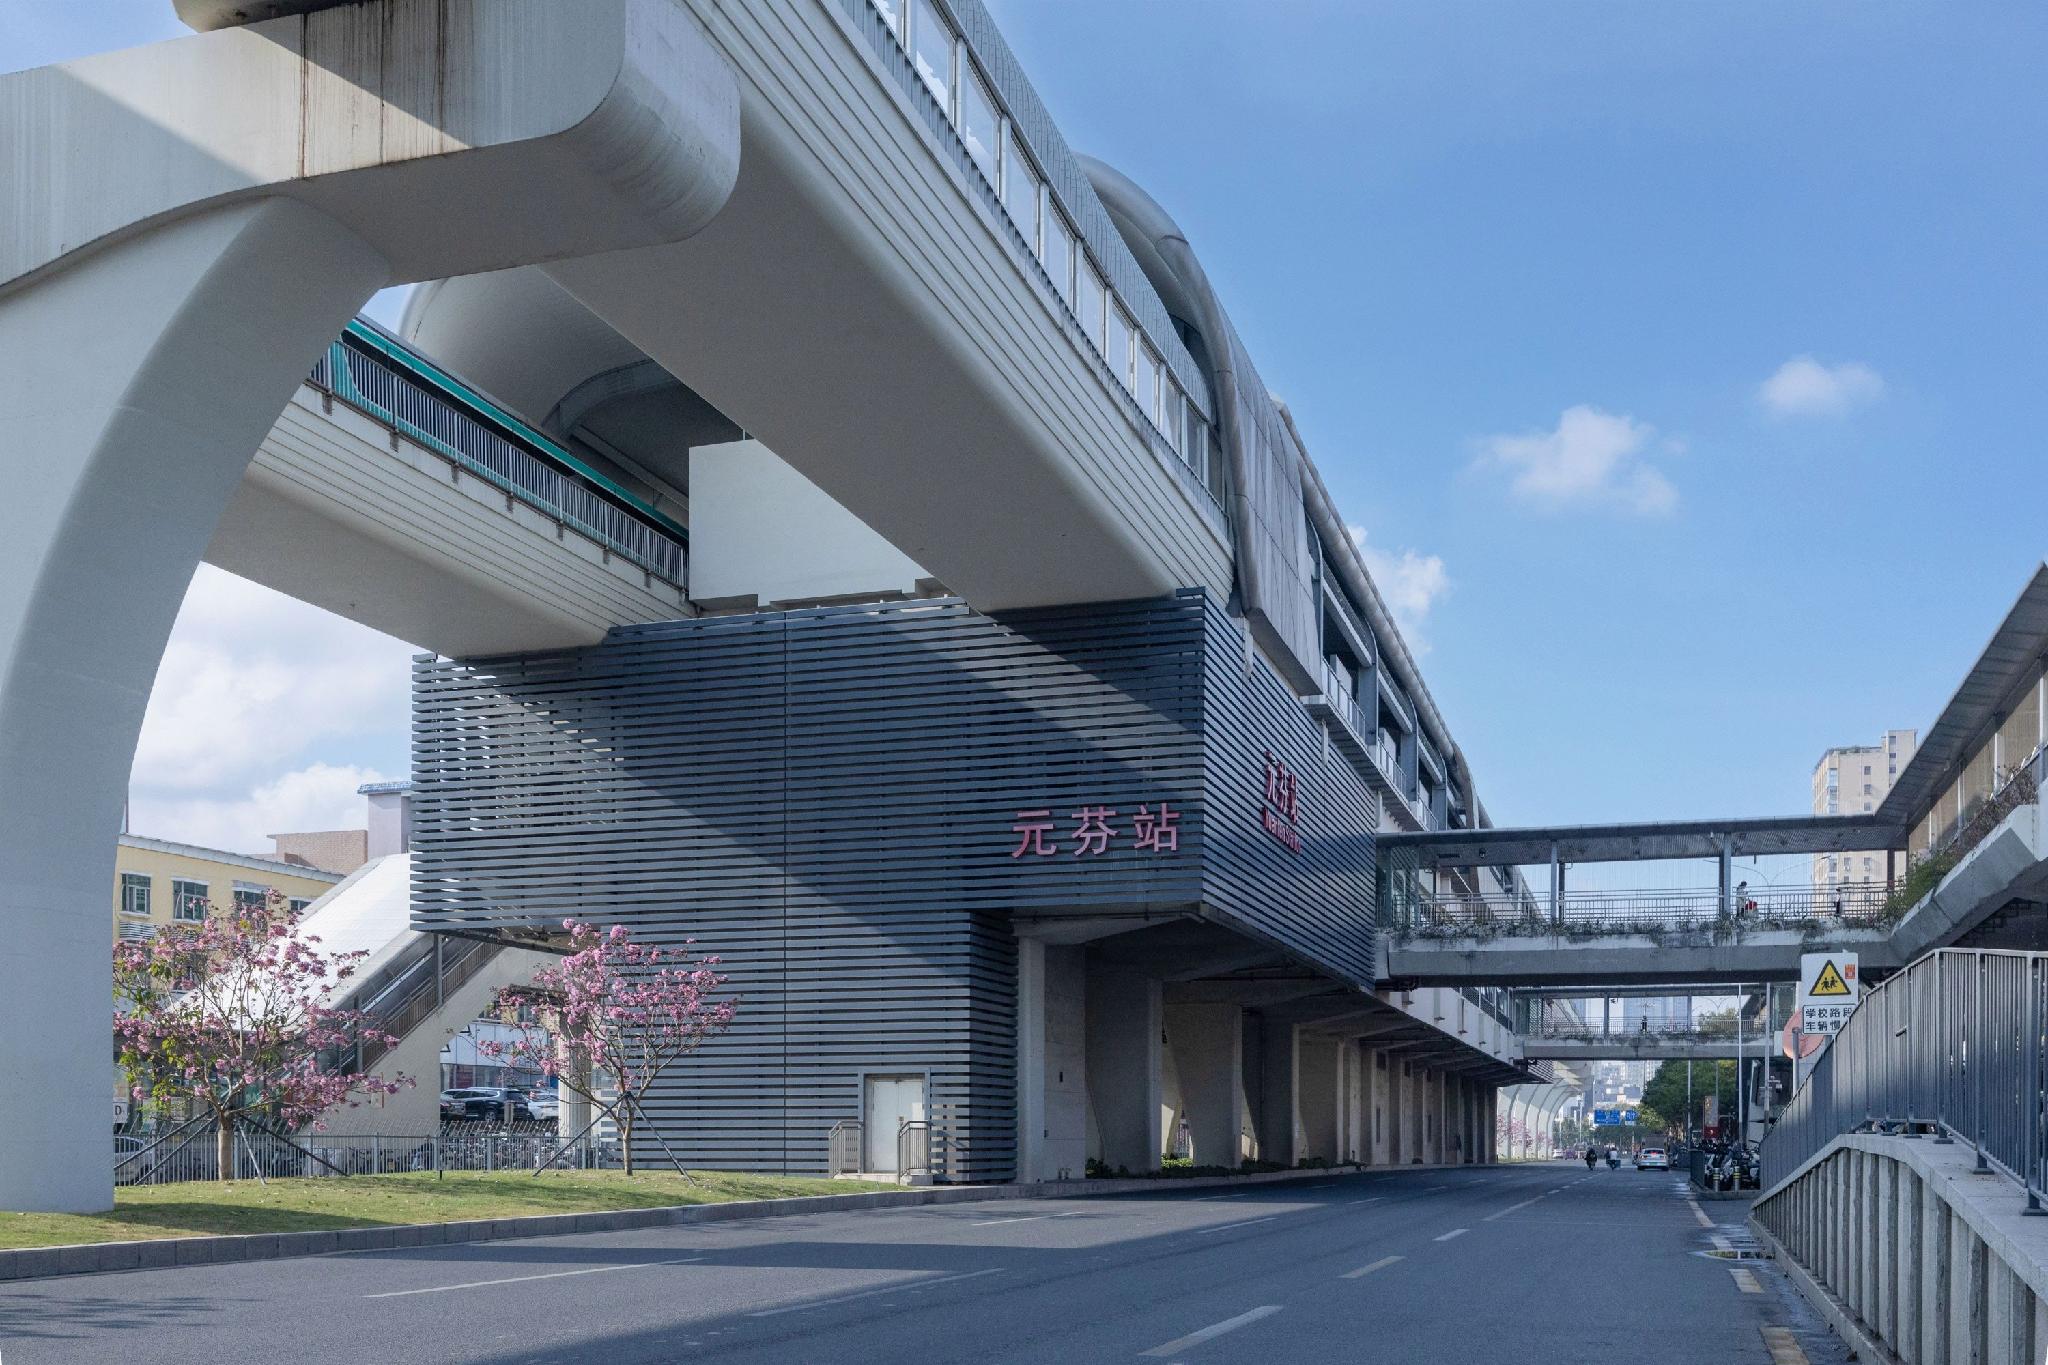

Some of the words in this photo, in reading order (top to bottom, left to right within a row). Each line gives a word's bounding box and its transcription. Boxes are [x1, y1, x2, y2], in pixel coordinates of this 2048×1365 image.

[1012, 802, 1181, 858] 元芬站
[1805, 1007, 1853, 1018] 学校路段
